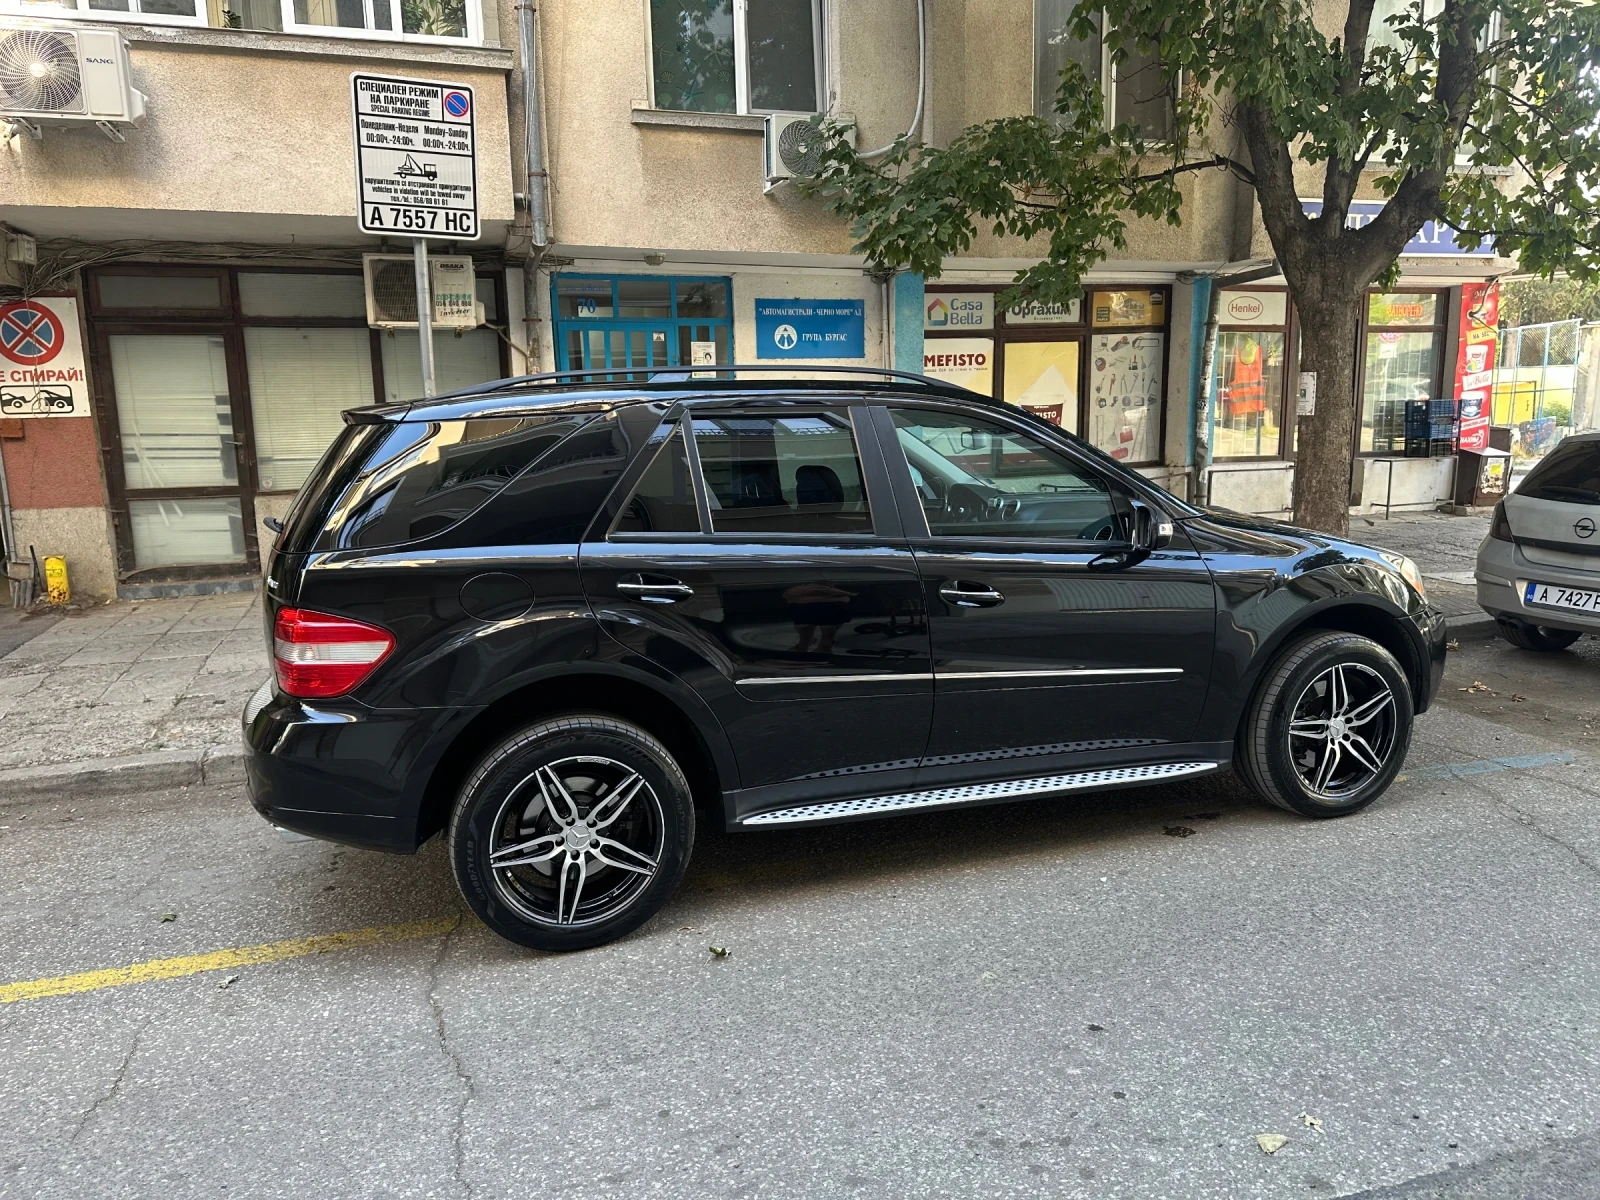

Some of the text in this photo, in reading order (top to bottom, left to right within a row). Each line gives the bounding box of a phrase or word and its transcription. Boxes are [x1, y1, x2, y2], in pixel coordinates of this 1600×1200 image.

[360, 81, 438, 99] СПЕЦИАЛЕН РЕЖИМ
[370, 94, 430, 109] НА ПАРКИРАНЕ
[370, 104, 430, 118] SPECIAL PARKING REGIME
[370, 206, 471, 232] A 7557 HC
[577, 298, 597, 314] 70
[950, 298, 983, 311] Casa
[1231, 303, 1260, 313] Henkel
[759, 308, 813, 316] "АВТОМАГИСТРАЛИ
[817, 308, 835, 316] ЧЕРНО
[835, 308, 853, 316] МОРЕ"
[854, 308, 862, 316] АД
[950, 312, 983, 325] Bella
[802, 333, 848, 341] ГРУПА БУРГАС
[923, 353, 986, 367] MEFISTO
[10, 367, 83, 382] СПИРАЙ!
[1539, 587, 1548, 602] A
[1555, 589, 1593, 608] 7427
[467, 840, 486, 900] GOODYEAR
